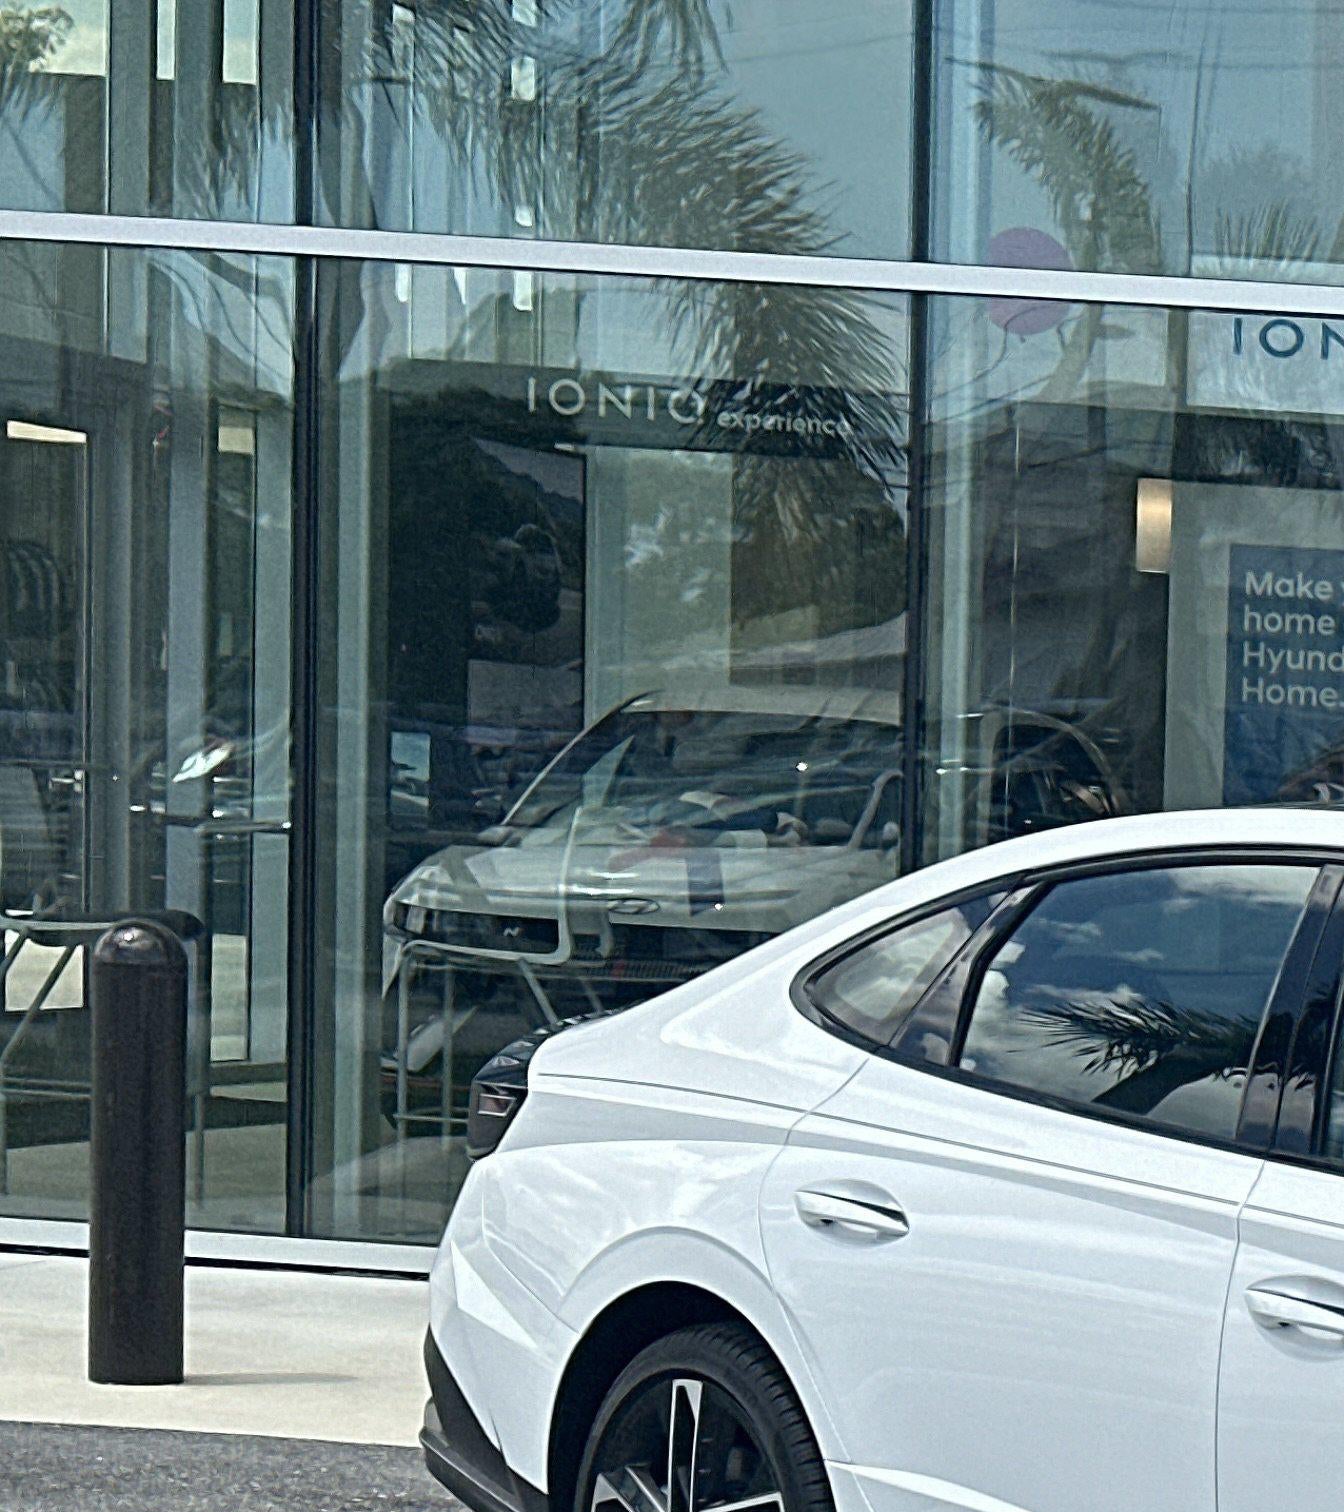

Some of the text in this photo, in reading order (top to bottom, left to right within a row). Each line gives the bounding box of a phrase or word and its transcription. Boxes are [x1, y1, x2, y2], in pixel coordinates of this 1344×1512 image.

[527, 376, 707, 425] IONIQ
[1245, 571, 1334, 600] Make
[1242, 604, 1336, 636] home
